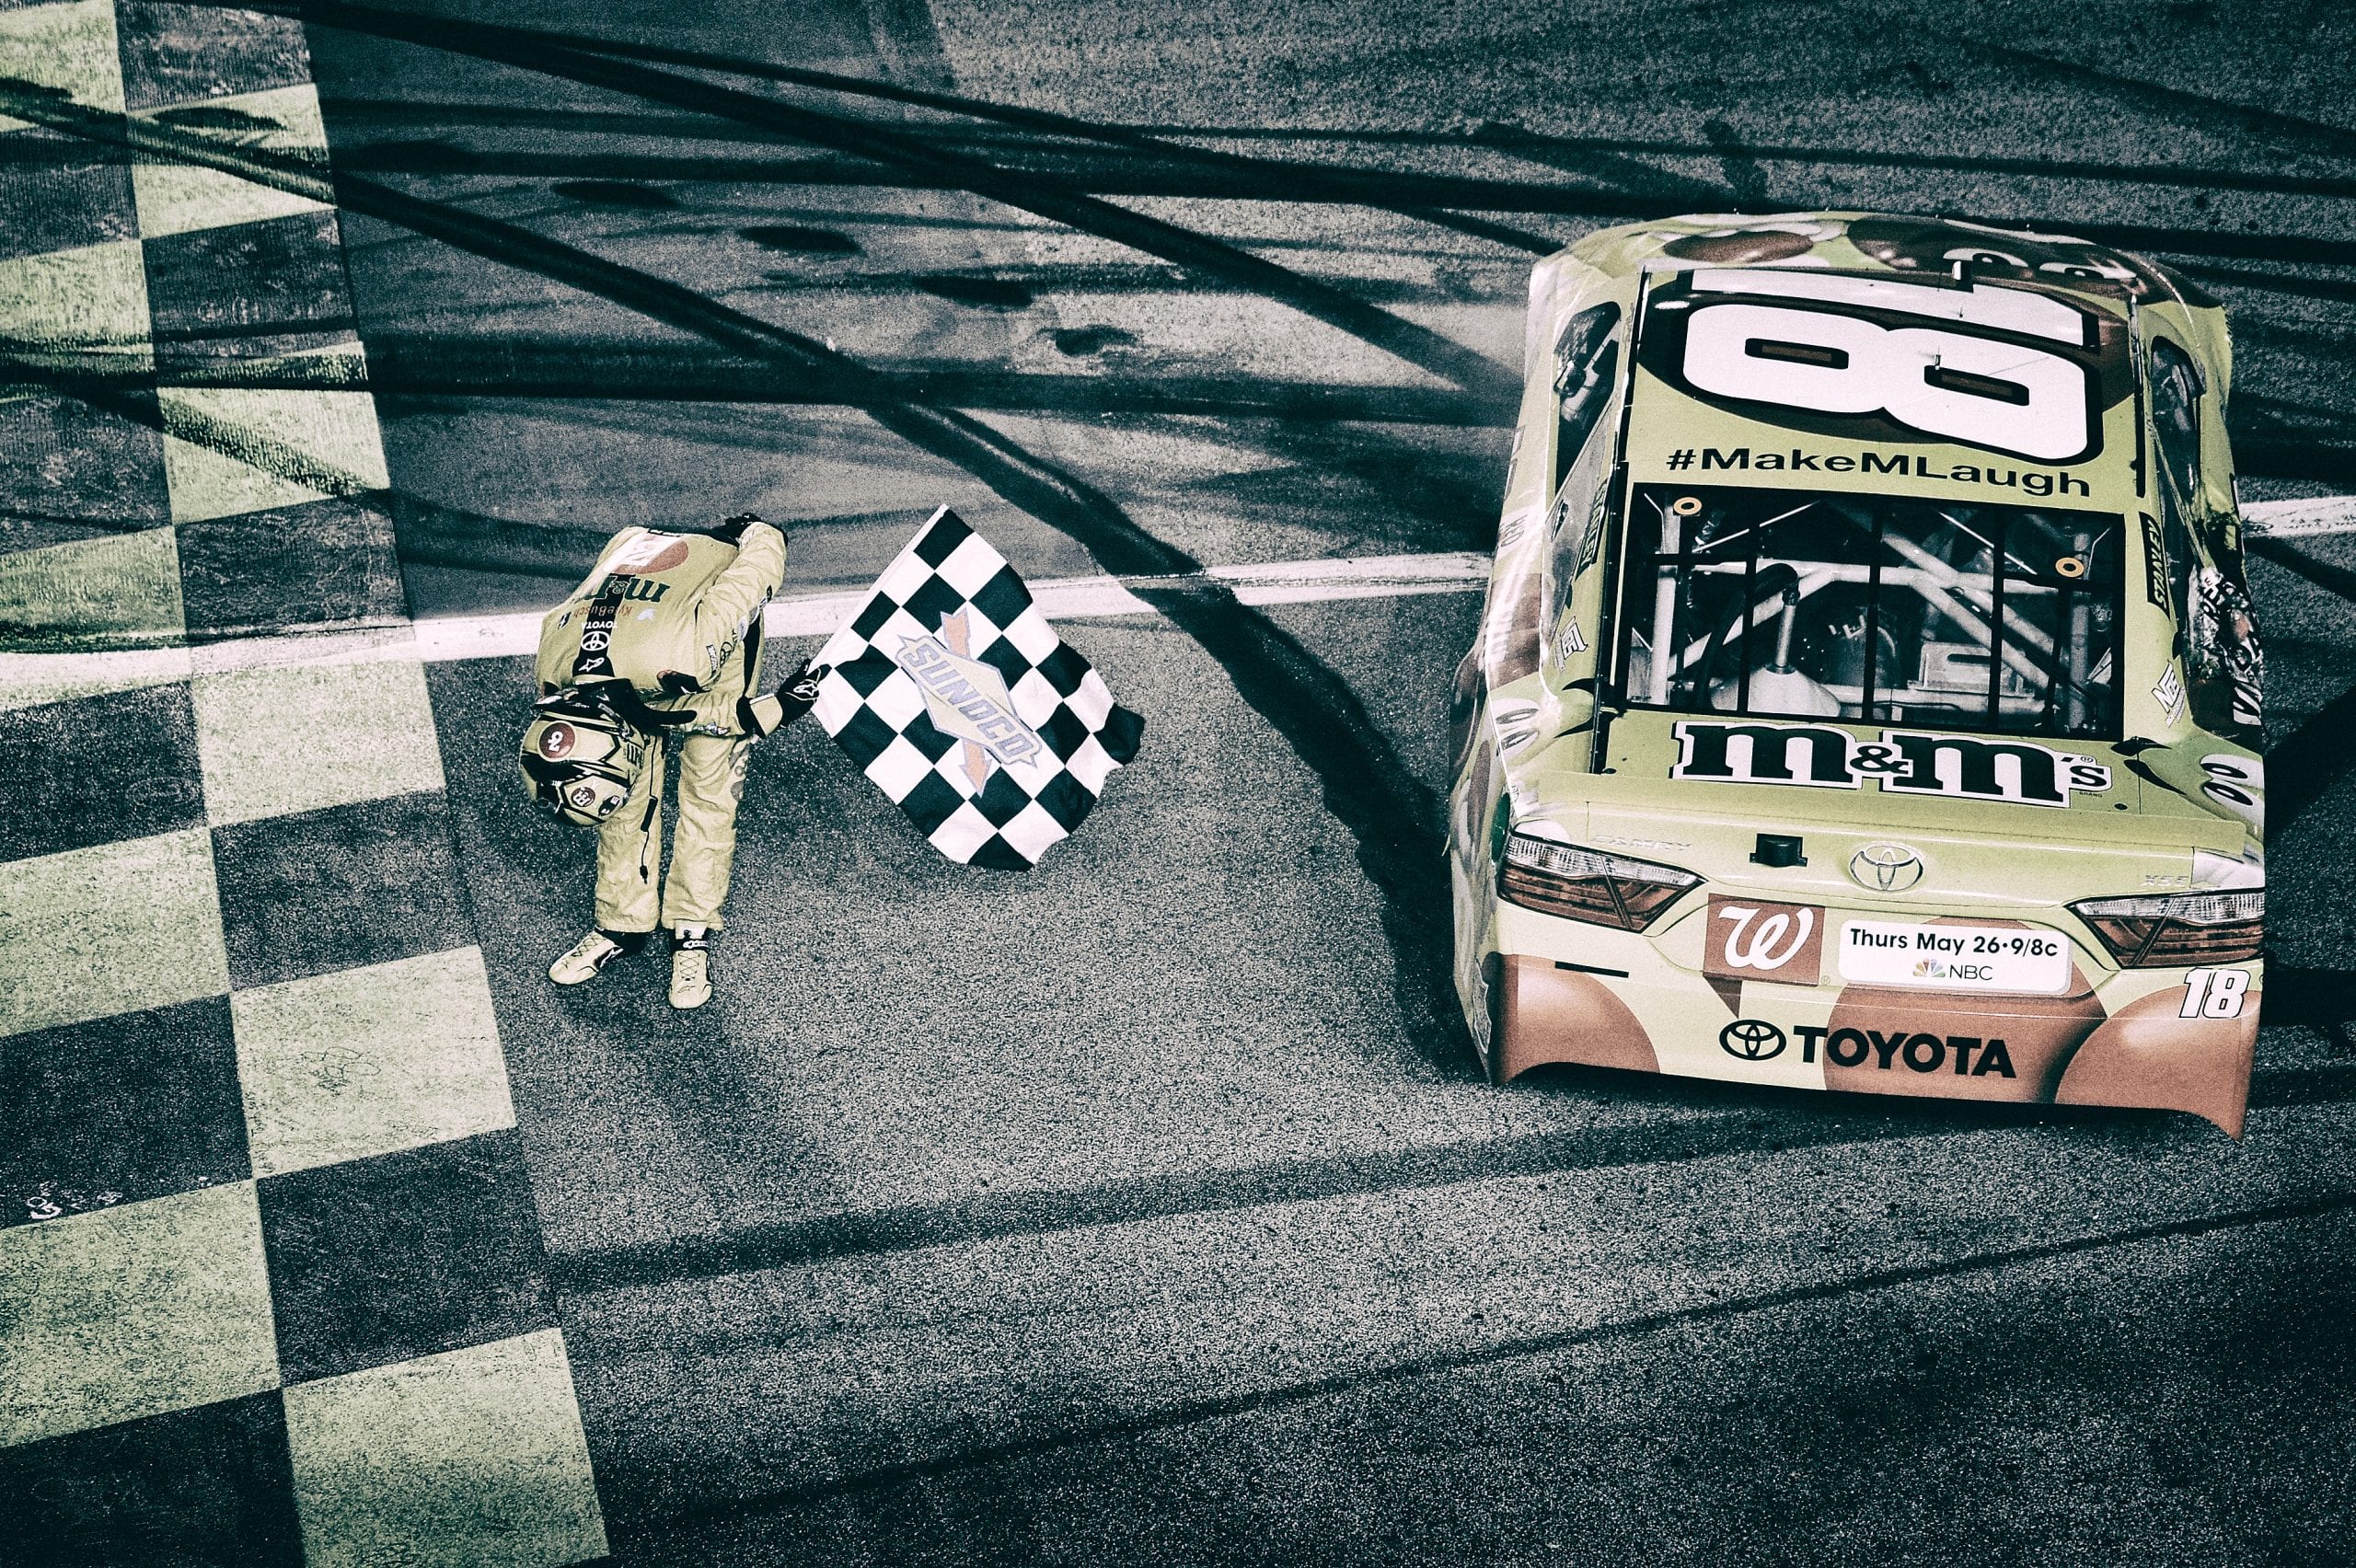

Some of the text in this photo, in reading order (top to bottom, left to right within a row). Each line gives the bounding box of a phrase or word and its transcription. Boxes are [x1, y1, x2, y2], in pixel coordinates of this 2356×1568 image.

[1666, 447, 2091, 497] #MakeMLaugh
[2146, 519, 2168, 610] STANLEY
[581, 620, 618, 630] TOYOTA
[907, 645, 1034, 756] SUNOCO
[1590, 835, 1693, 851] CAMRY
[1850, 928, 1908, 949] Thurs
[1917, 932, 1965, 956] May
[1949, 963, 1993, 981] NBC
[2178, 966, 2251, 1019] 18
[1793, 1024, 2017, 1079] TOYOTA
